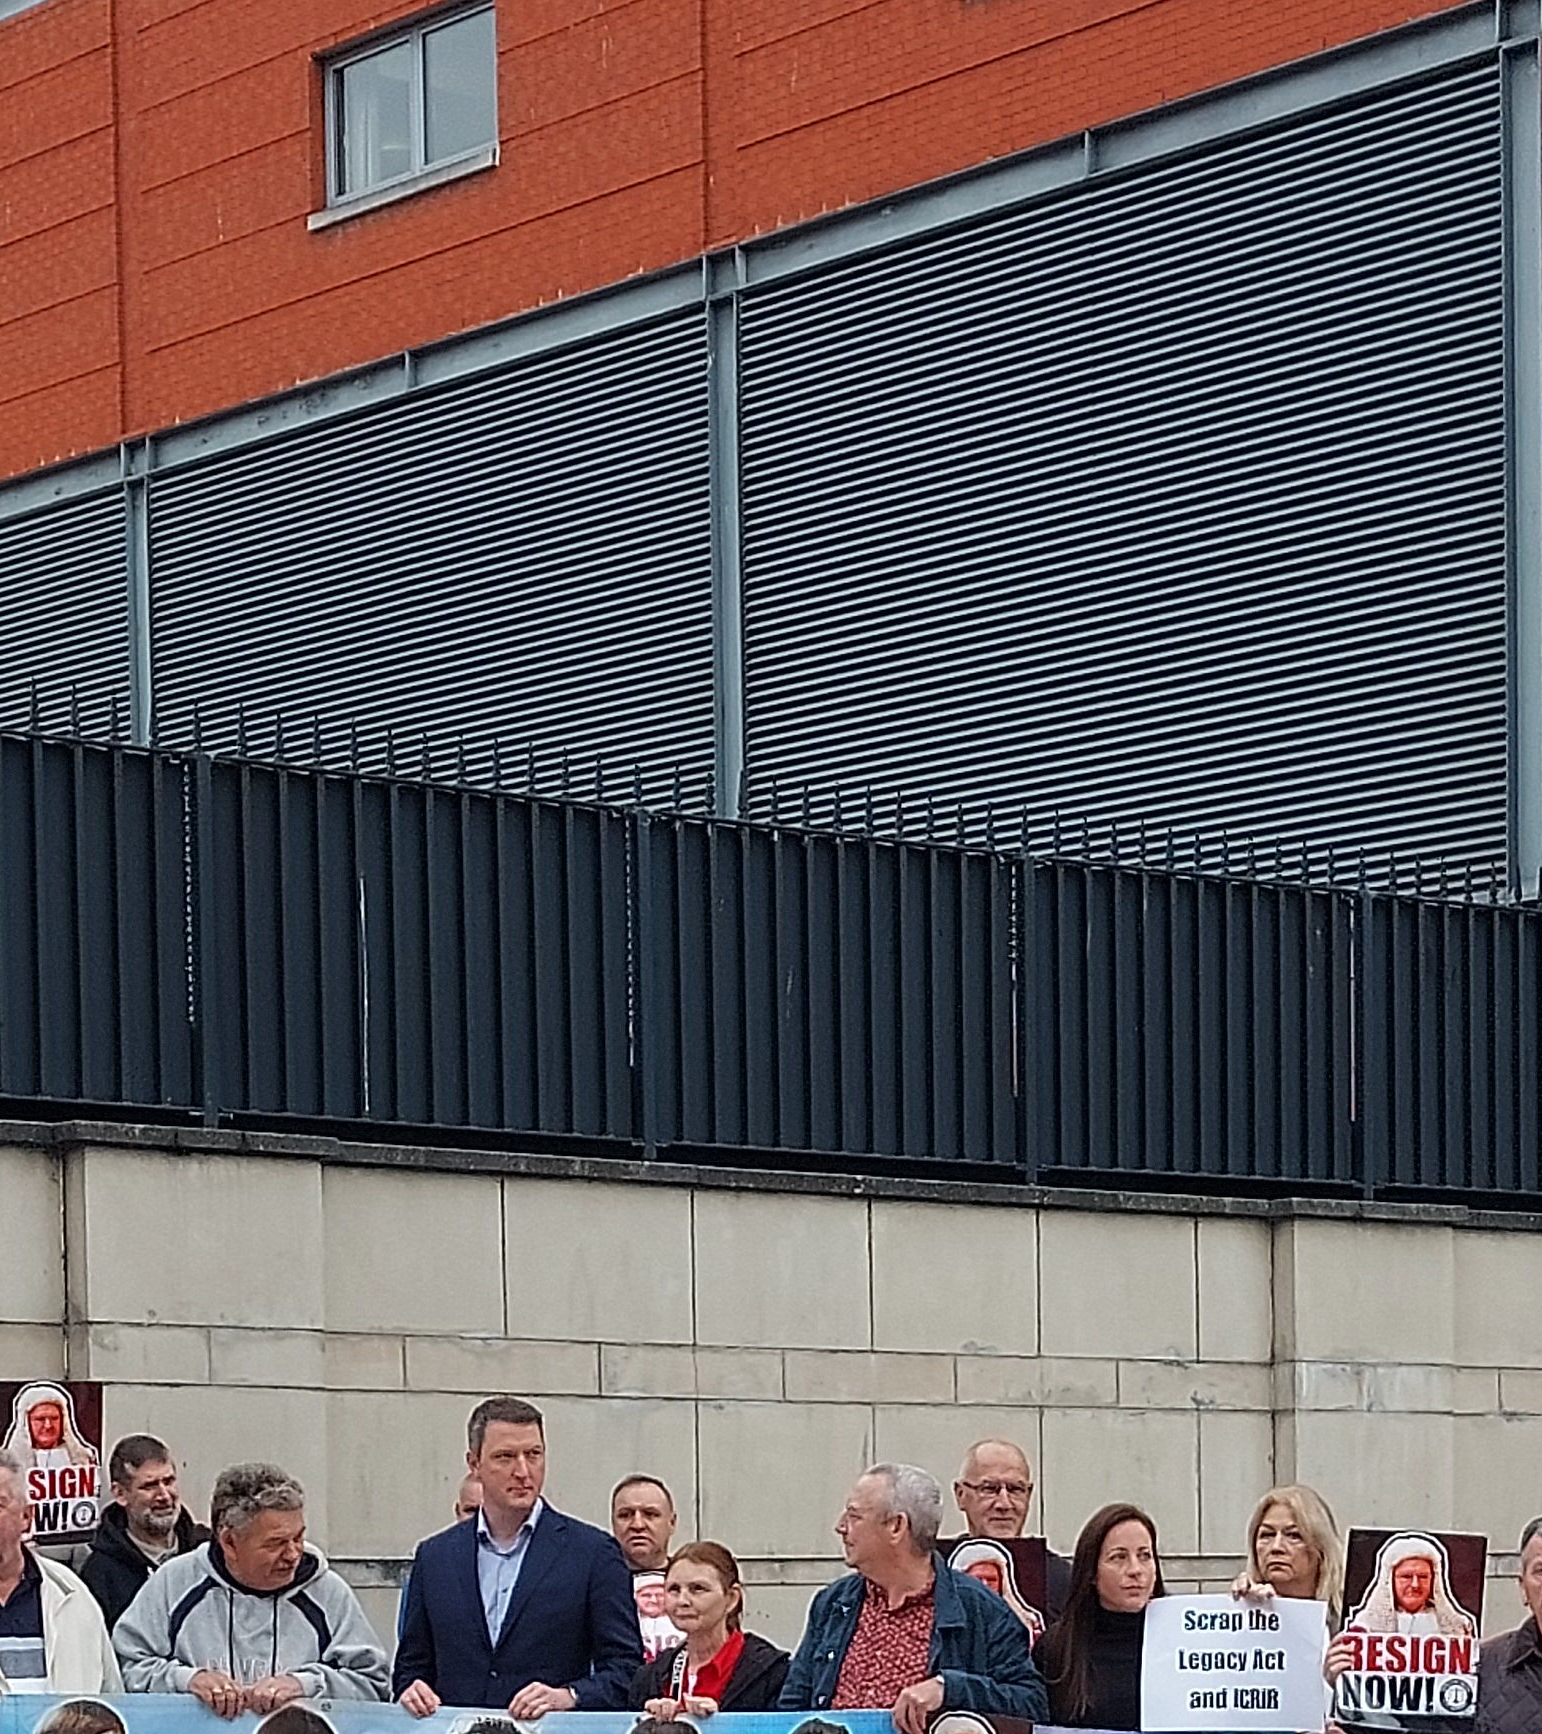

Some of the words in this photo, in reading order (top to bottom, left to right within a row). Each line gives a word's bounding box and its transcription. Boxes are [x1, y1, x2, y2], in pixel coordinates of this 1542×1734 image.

[28, 1466, 96, 1501] SIGN
[1184, 1609, 1243, 1632] Scrap
[1248, 1609, 1280, 1632] the
[1178, 1650, 1247, 1672] Legacy
[1252, 1649, 1286, 1670] Act
[1189, 1687, 1228, 1709] and
[1341, 1673, 1436, 1712] NOW!
